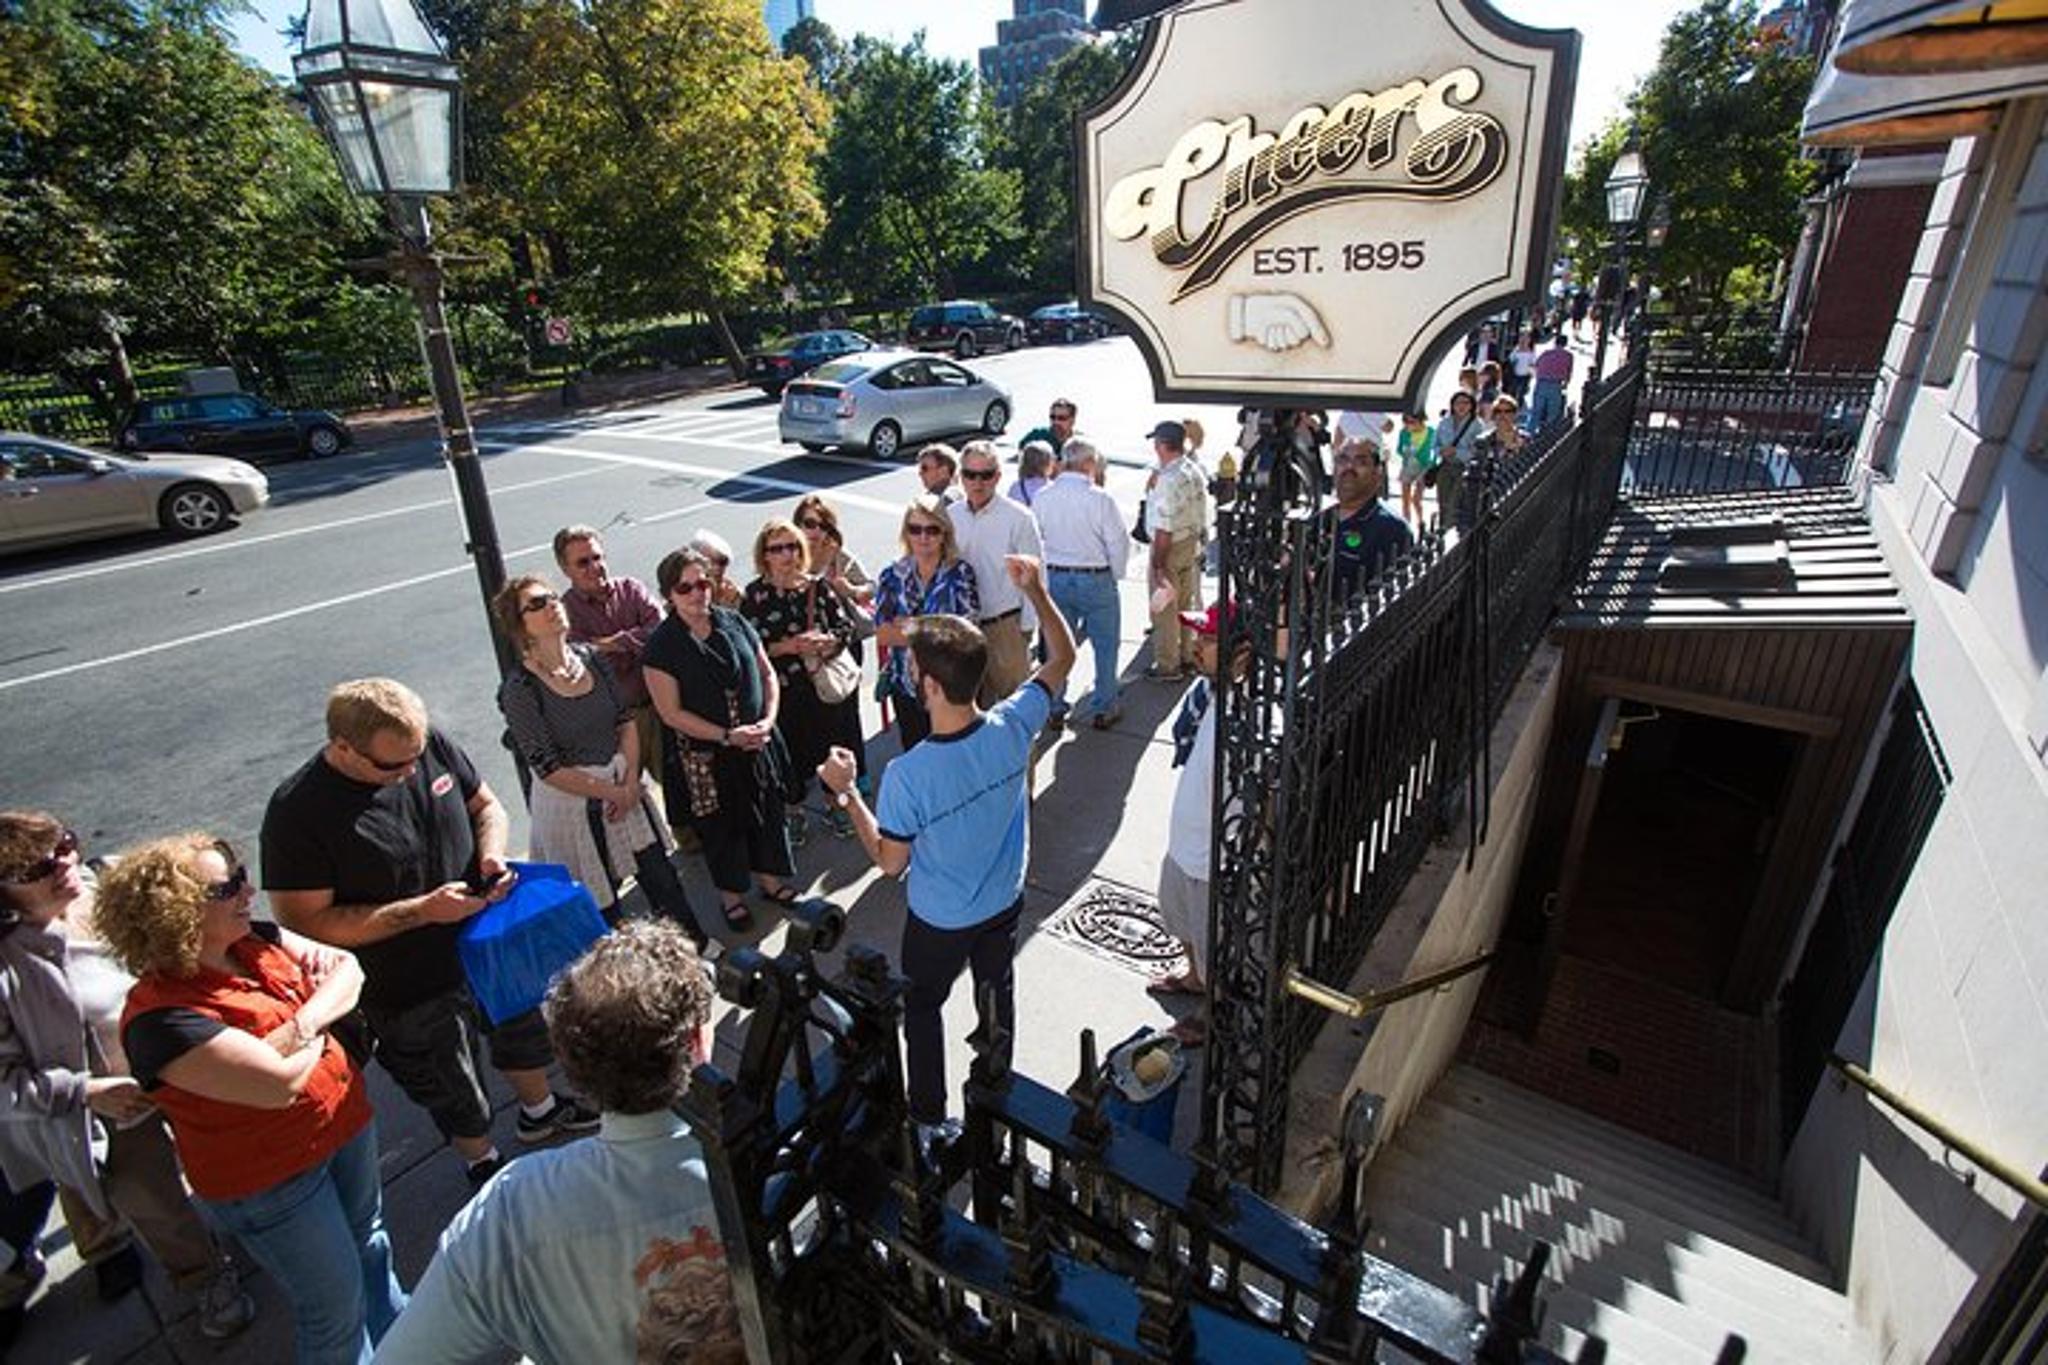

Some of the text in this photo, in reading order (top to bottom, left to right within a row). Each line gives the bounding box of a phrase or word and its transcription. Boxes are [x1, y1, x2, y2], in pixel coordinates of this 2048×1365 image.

[1104, 66, 1508, 302] Cheers
[1253, 241, 1425, 275] EST. 1895
